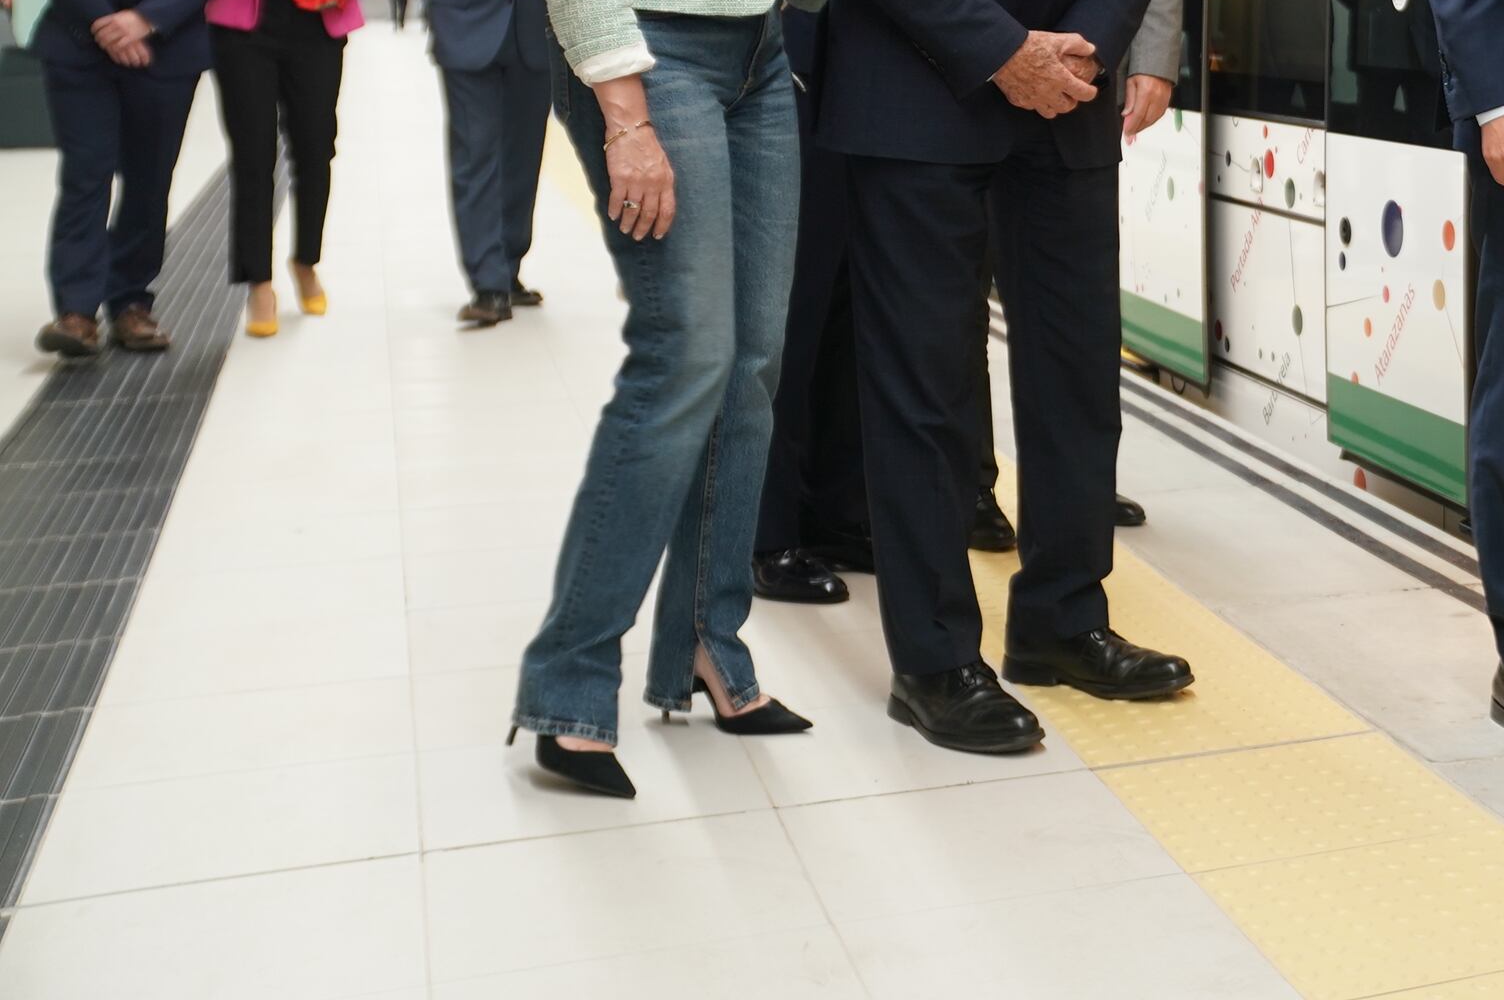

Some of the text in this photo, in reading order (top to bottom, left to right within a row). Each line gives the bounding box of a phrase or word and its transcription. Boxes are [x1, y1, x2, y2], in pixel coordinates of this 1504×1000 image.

[1296, 127, 1314, 165] Carr
[1229, 230, 1253, 292] Portada
[1374, 283, 1416, 386] Atarazanas
[1262, 352, 1292, 426] Barbrela
